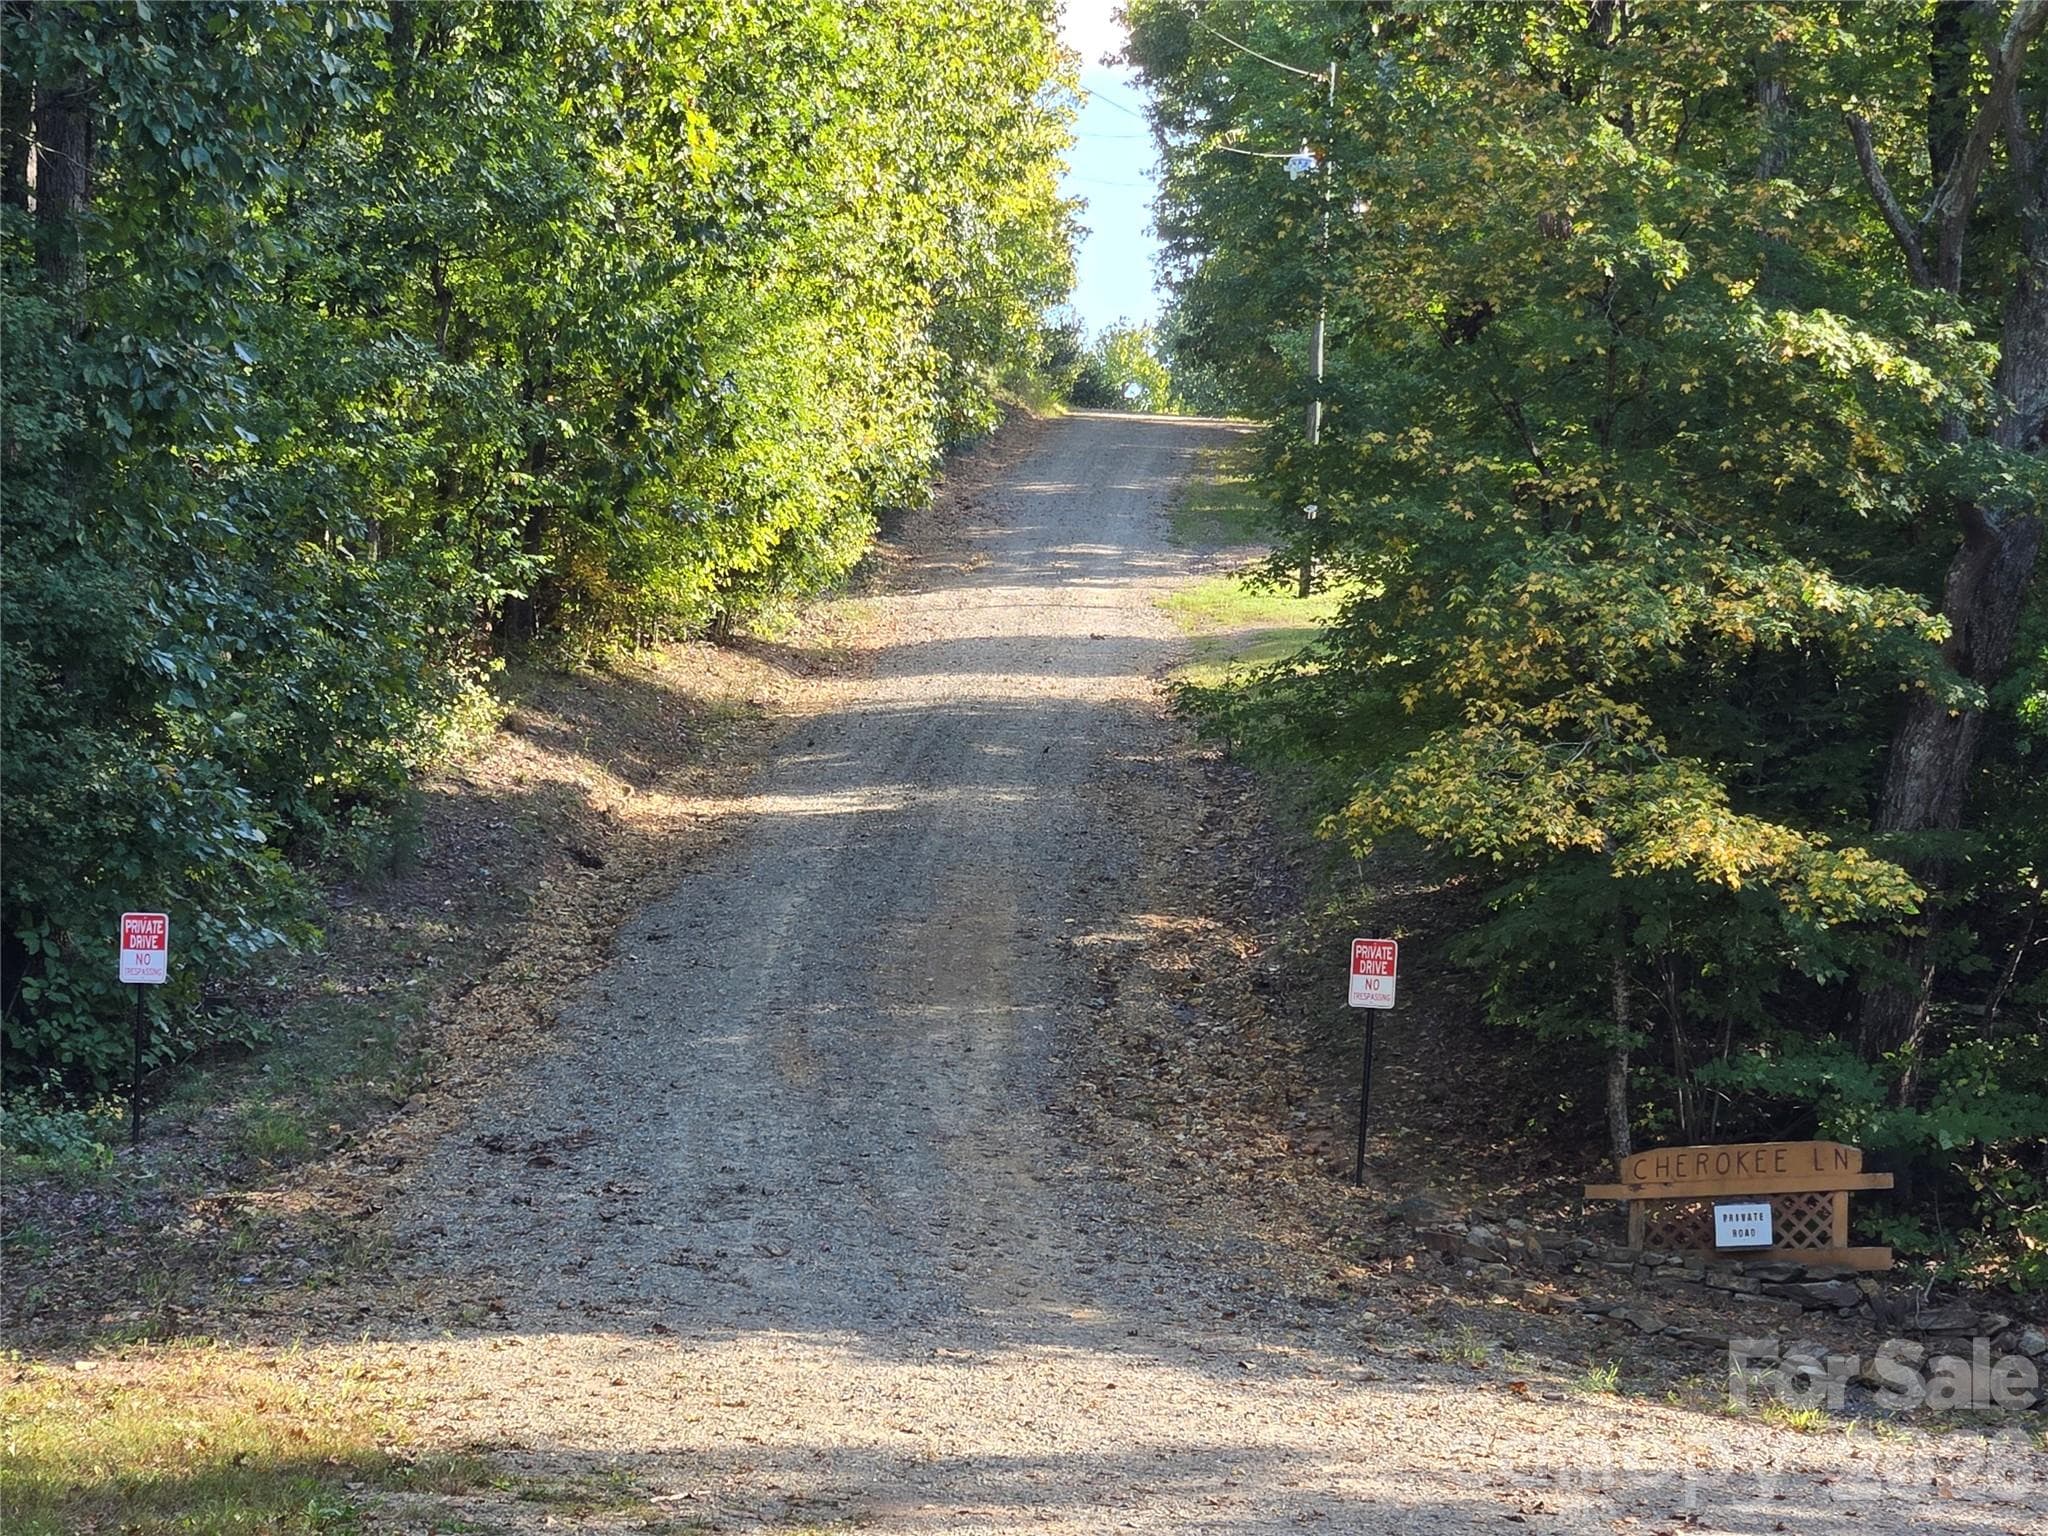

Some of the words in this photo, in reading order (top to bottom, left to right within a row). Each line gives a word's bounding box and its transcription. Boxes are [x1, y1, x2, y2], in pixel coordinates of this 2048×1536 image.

[125, 919, 164, 934] PRIVATE
[130, 935, 159, 948] DRIVE
[135, 953, 151, 965] NO
[1356, 945, 1393, 960] PRIVATE
[125, 967, 162, 976] TRESPASSING
[1359, 960, 1388, 975] DRIVE
[1365, 978, 1380, 991] NO
[1353, 992, 1392, 1002] TRESPASSING
[1633, 1148, 1788, 1180] CHEROKEE
[1813, 1147, 1849, 1172] LN
[1722, 1211, 1765, 1224] PRIVATE
[1732, 1228, 1757, 1238] ROAD
